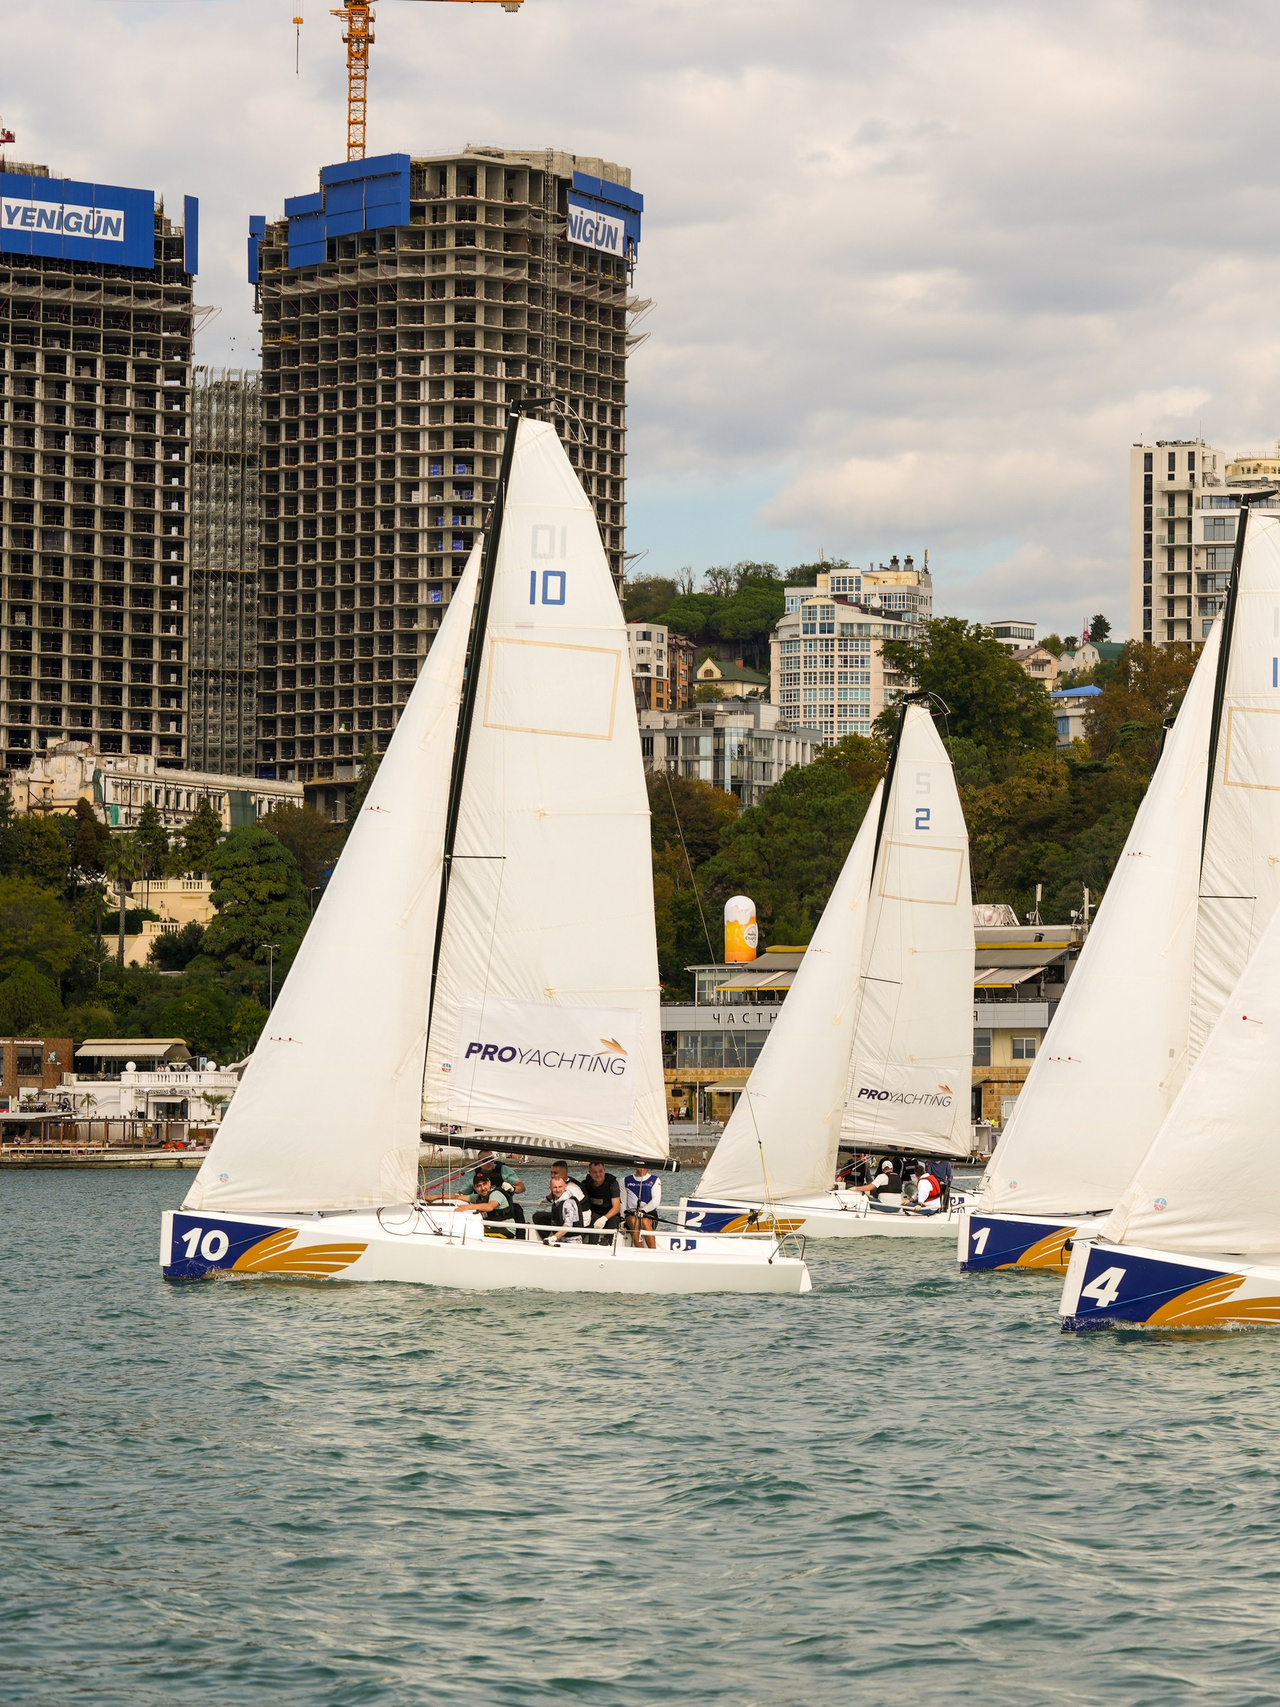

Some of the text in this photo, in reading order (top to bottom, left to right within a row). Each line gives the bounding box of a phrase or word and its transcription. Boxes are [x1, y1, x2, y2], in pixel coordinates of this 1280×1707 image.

[529, 570, 566, 605] 10
[915, 808, 930, 830] 2
[464, 1042, 627, 1076] PROYACHTING
[857, 1087, 953, 1107] PROYACHTING
[181, 1227, 229, 1262] 10
[971, 1227, 991, 1255] 1
[1081, 1266, 1127, 1307] 4
